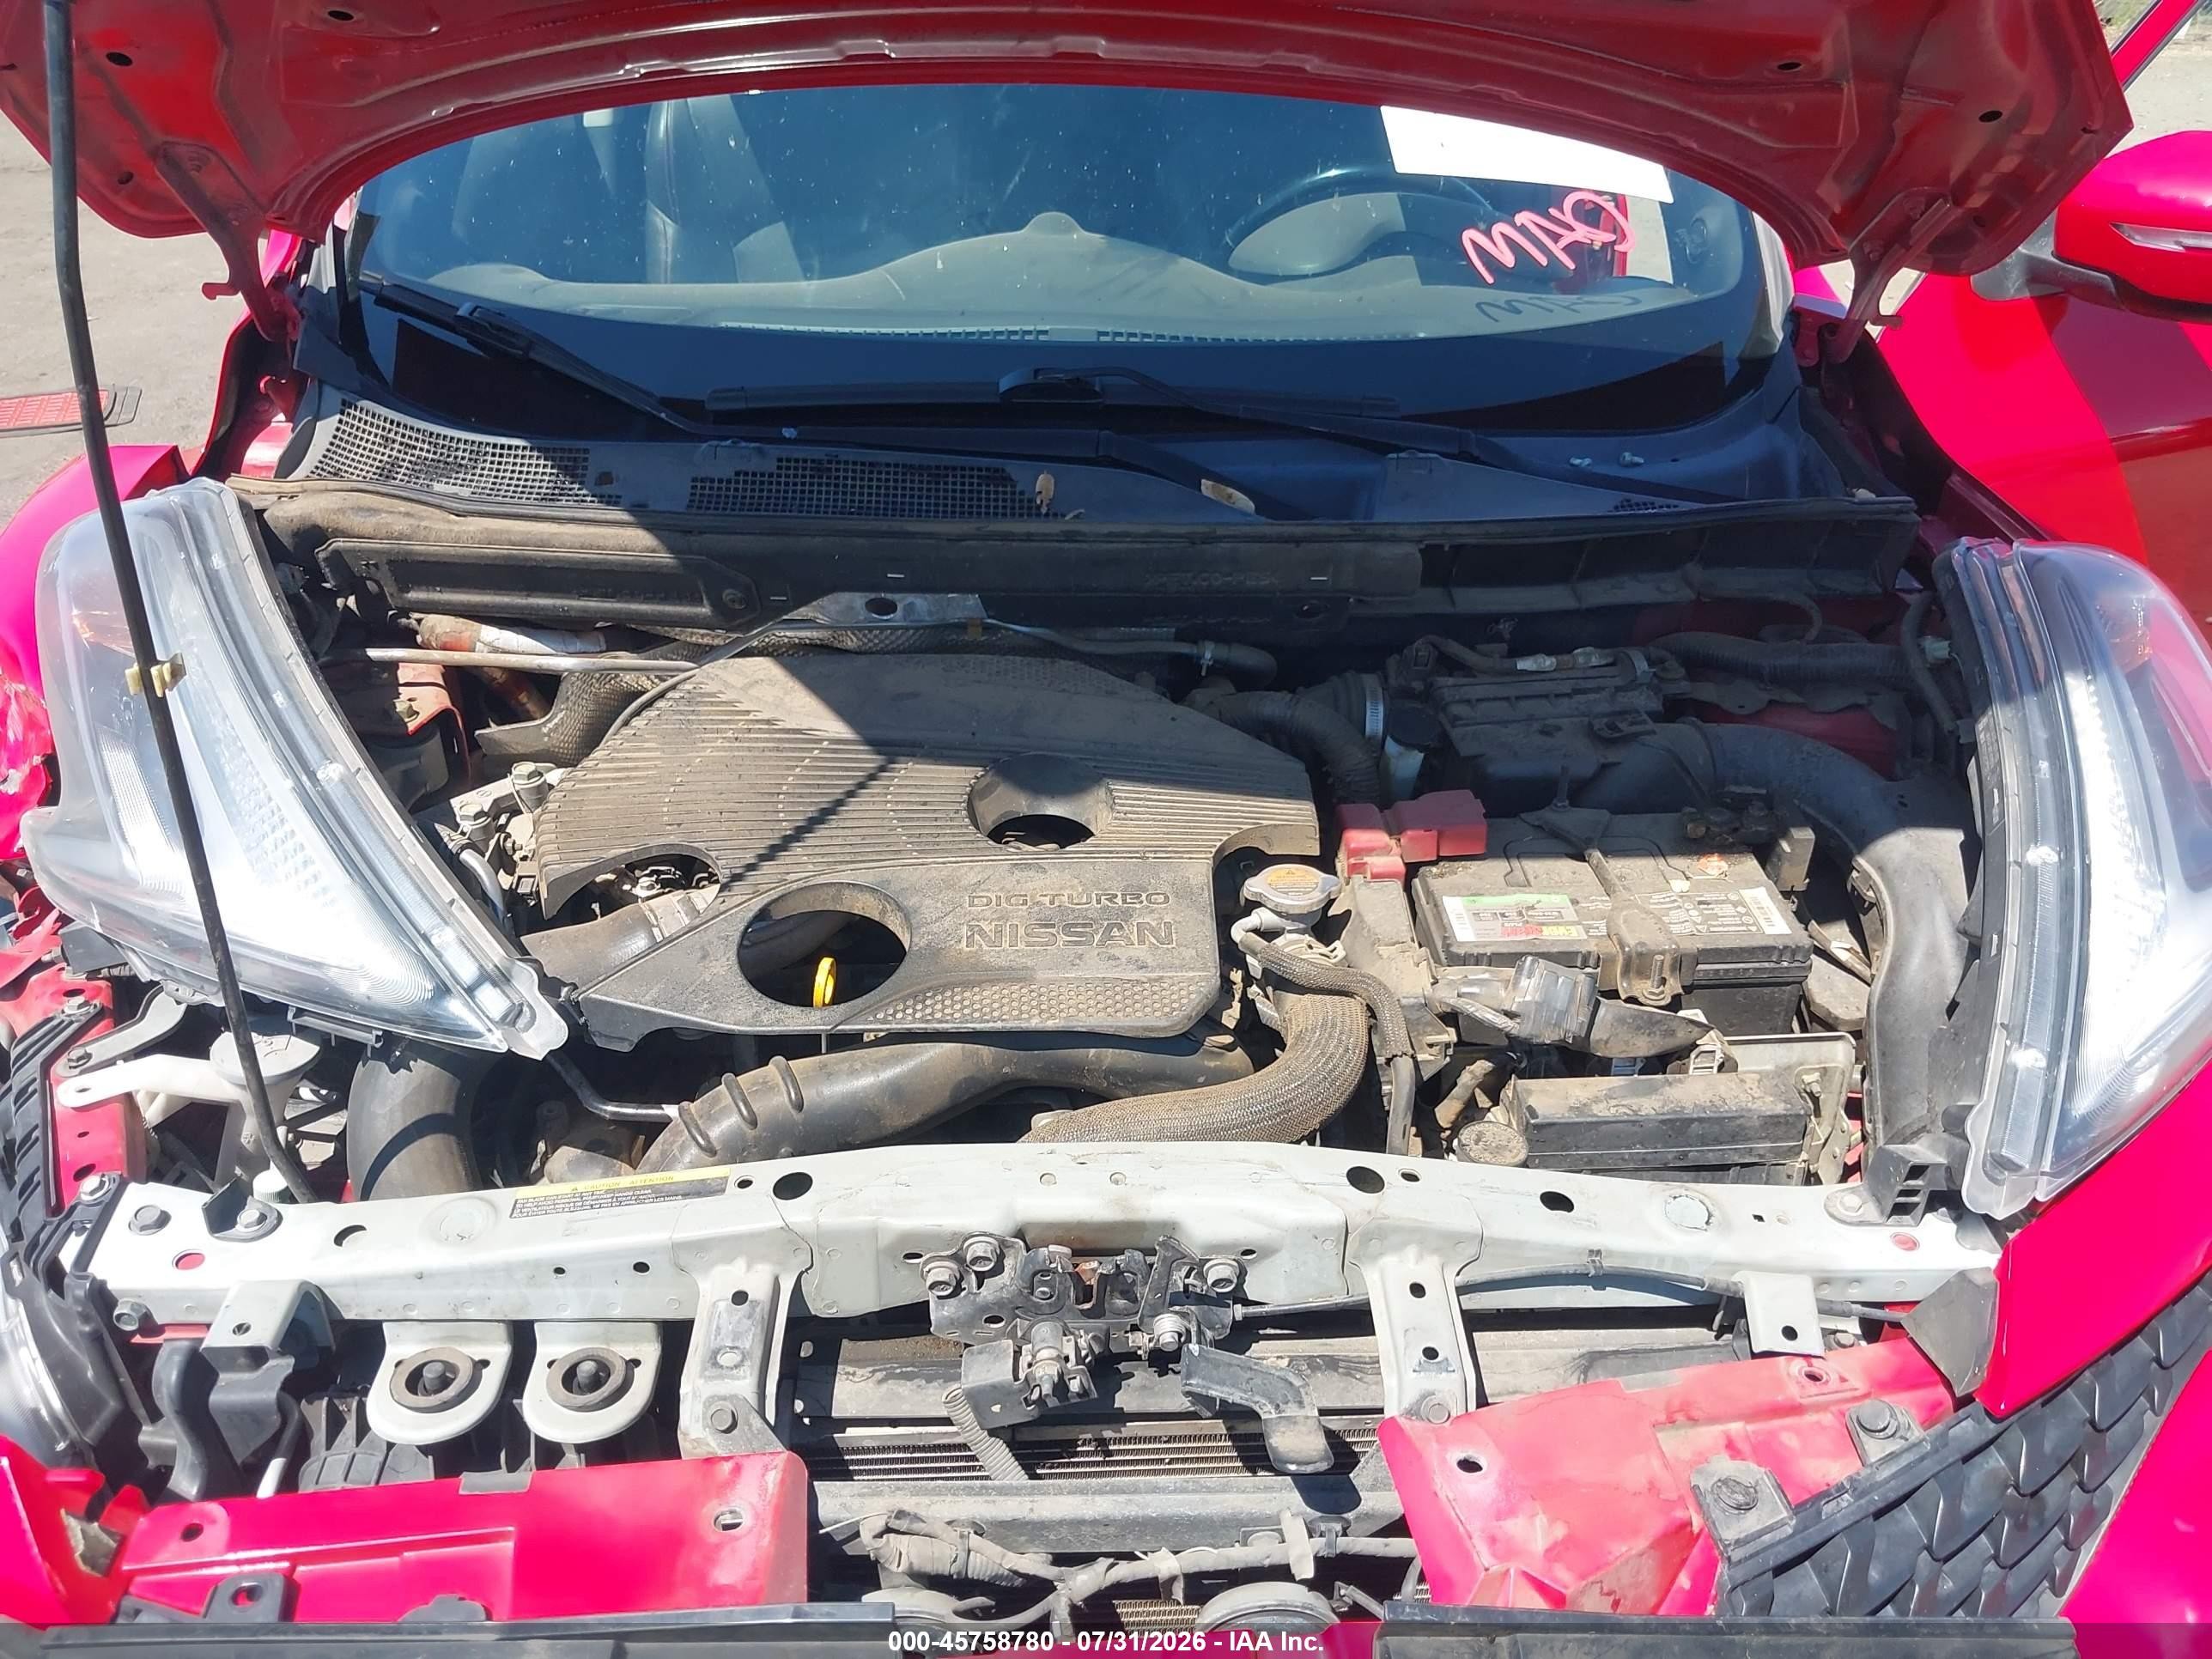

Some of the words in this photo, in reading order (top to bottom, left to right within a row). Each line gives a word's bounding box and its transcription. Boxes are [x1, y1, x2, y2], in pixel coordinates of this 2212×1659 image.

[967, 893, 1028, 908] DIG
[1038, 891, 1170, 907] TURBO
[965, 921, 1176, 948] NISSAN
[629, 1176, 673, 1184] ATTENTION
